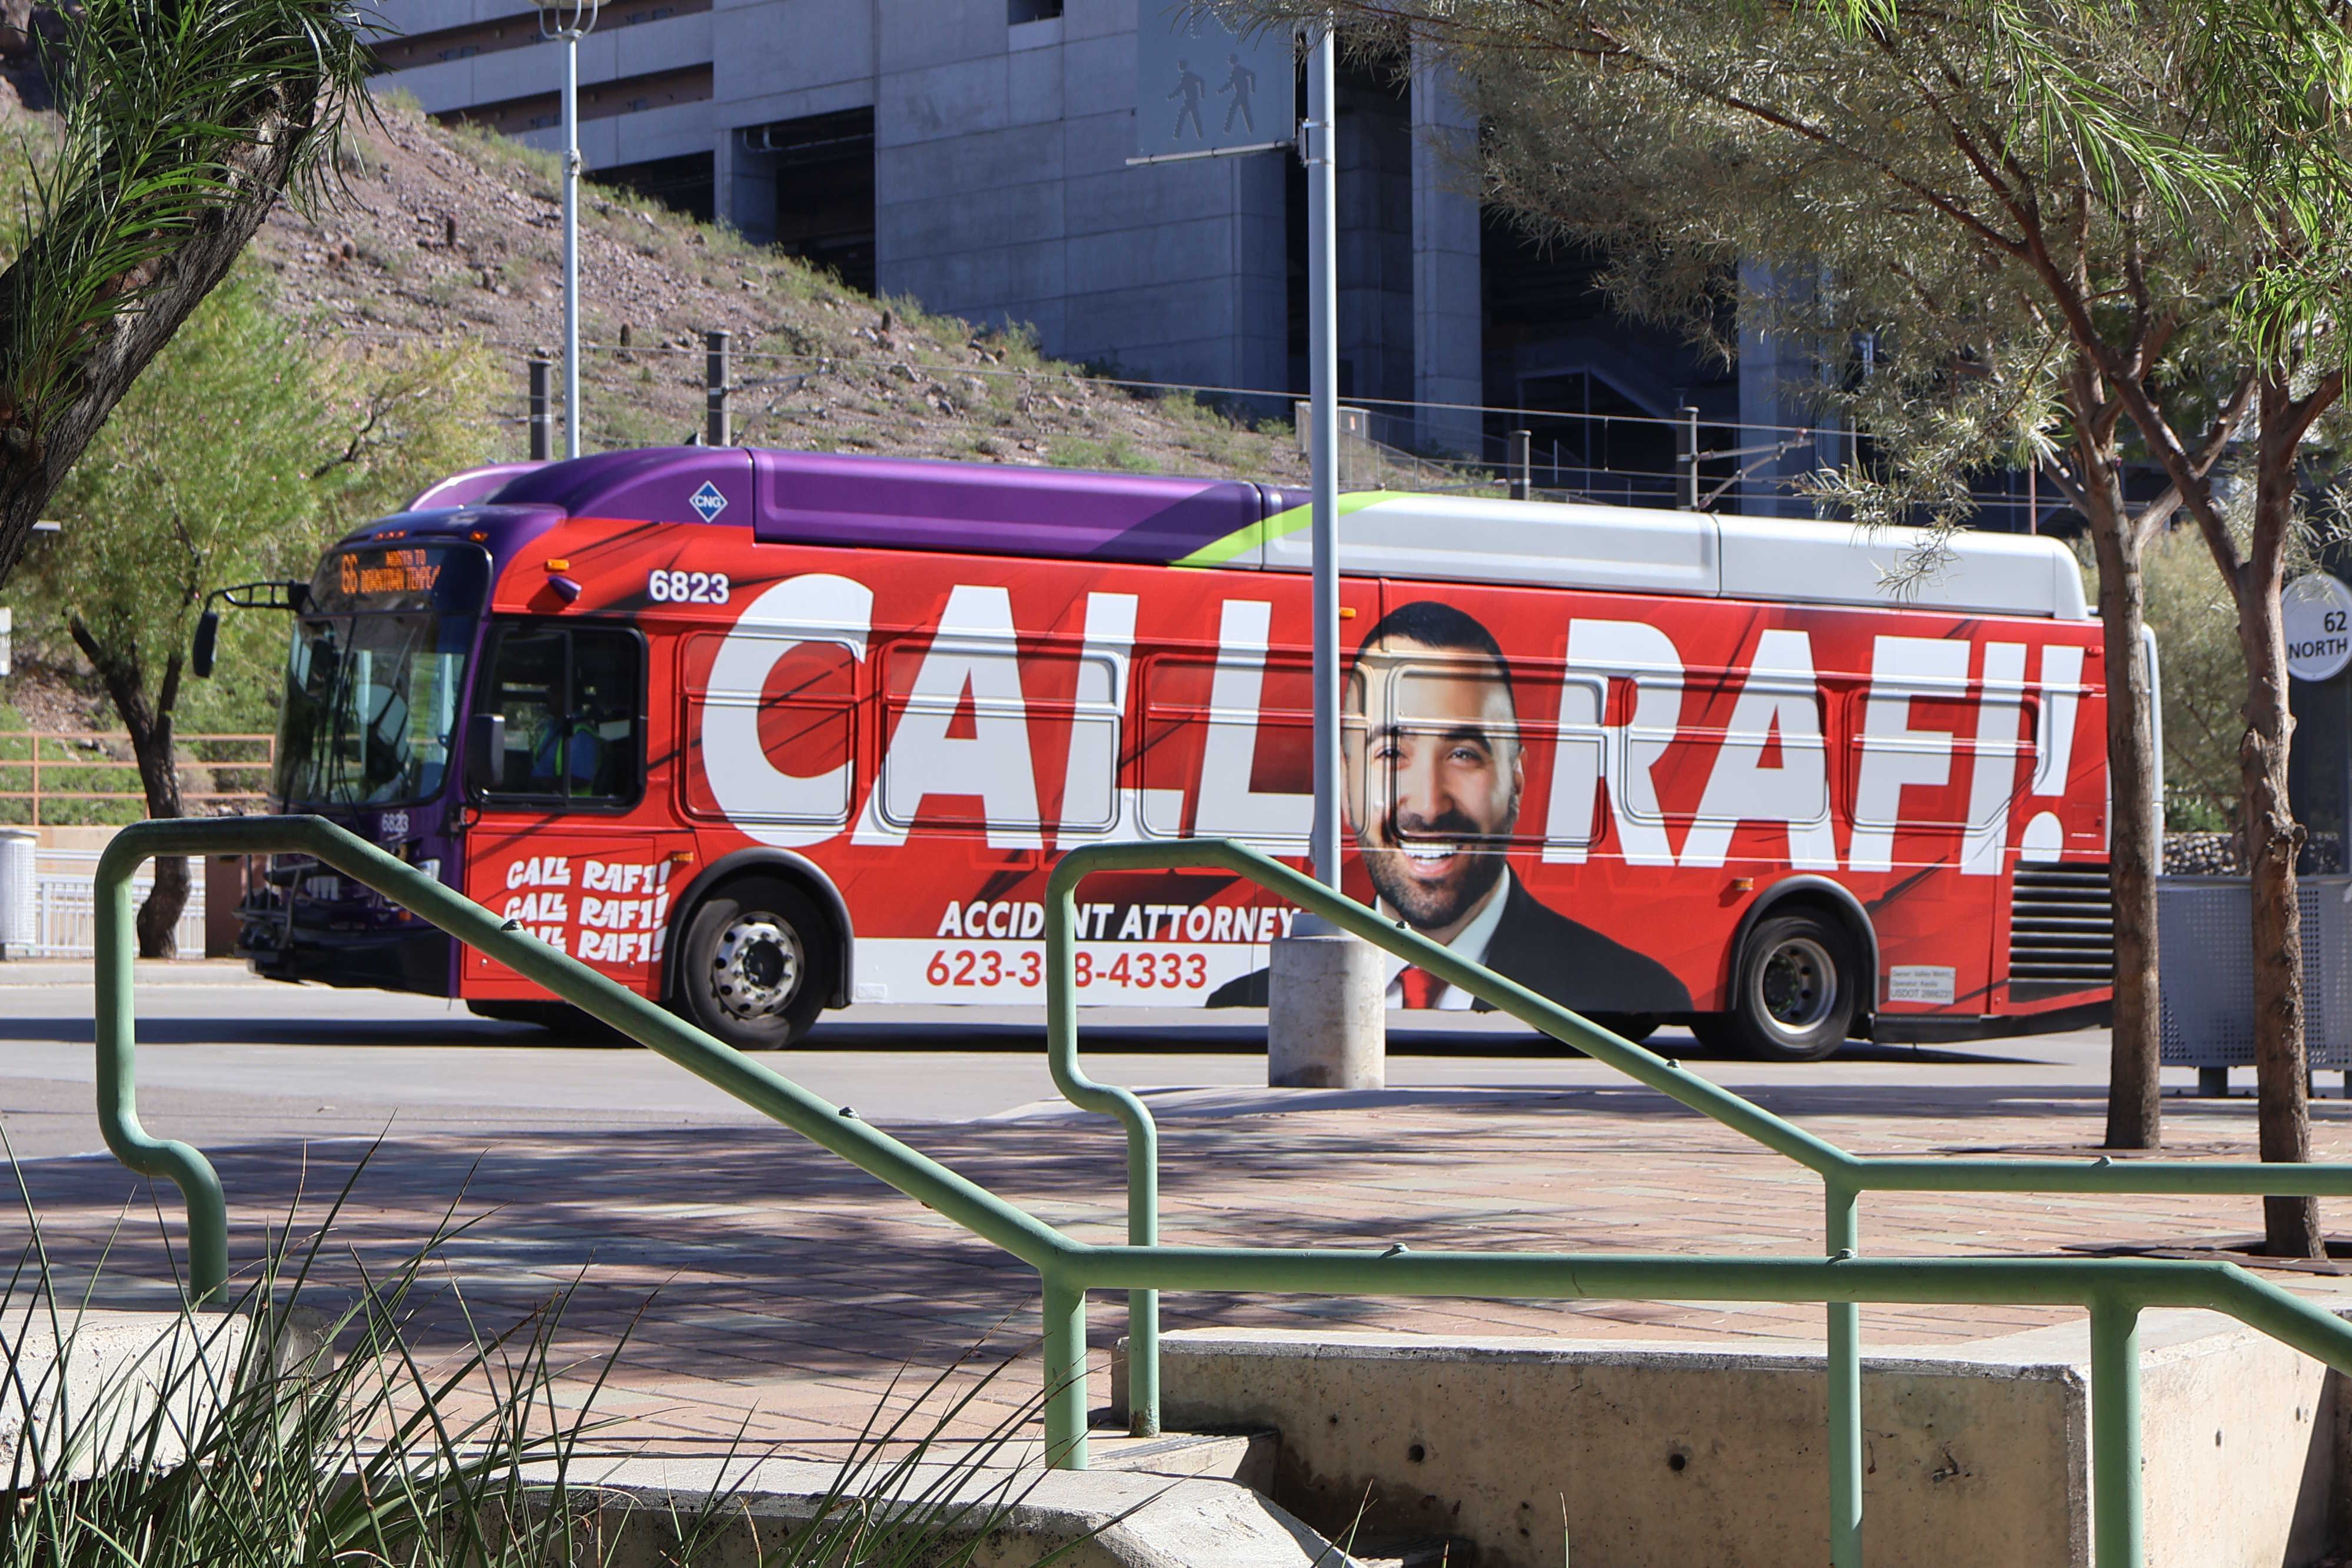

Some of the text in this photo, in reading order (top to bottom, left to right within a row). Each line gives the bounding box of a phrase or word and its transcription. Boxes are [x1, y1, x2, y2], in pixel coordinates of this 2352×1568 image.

[695, 495, 722, 509] CNG
[650, 570, 729, 604] 6823
[2325, 612, 2347, 632] 62
[2289, 638, 2347, 659] NORTH
[702, 573, 2085, 875] CALL RAFI!
[507, 856, 671, 894] CALL RAFI!
[504, 892, 670, 929] CALL RAFI!
[937, 901, 1301, 942] ACCIDNT ATTORNEY
[577, 926, 667, 962] RAFI!
[926, 950, 1207, 988] 623-38-4333
